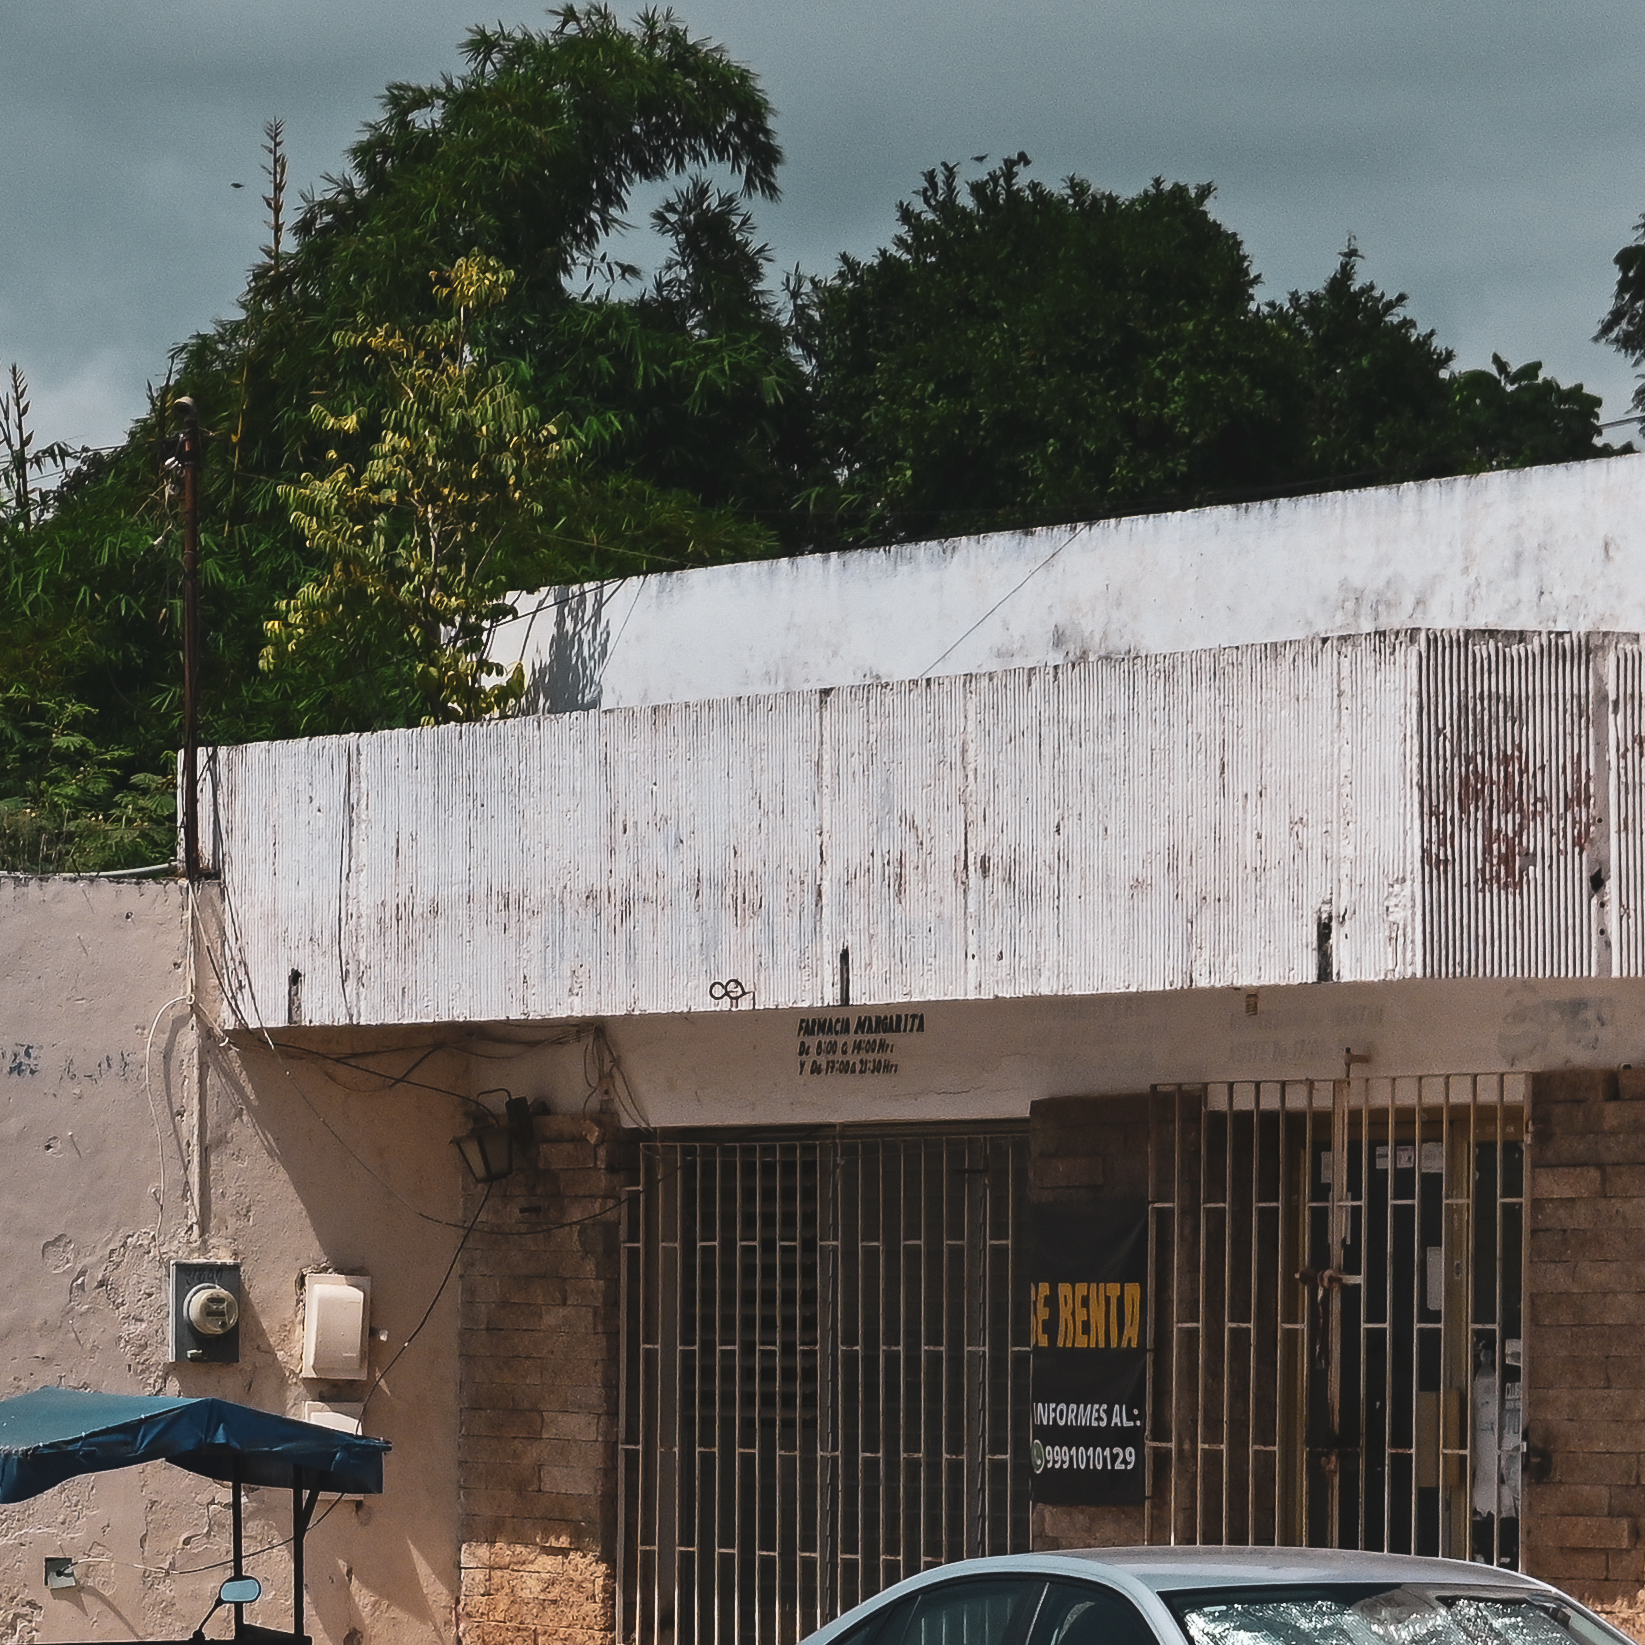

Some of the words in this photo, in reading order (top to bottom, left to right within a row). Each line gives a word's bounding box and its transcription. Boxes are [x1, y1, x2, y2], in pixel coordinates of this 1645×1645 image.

[797, 1017, 850, 1037] FARMACIA
[854, 1013, 925, 1035] MARGARITA
[798, 1060, 806, 1075] Y
[1057, 1282, 1141, 1348] RENTA
[1033, 1402, 1107, 1427] INFORMES
[1110, 1404, 1141, 1427] AL:
[1045, 1445, 1136, 1470] 9991010129
